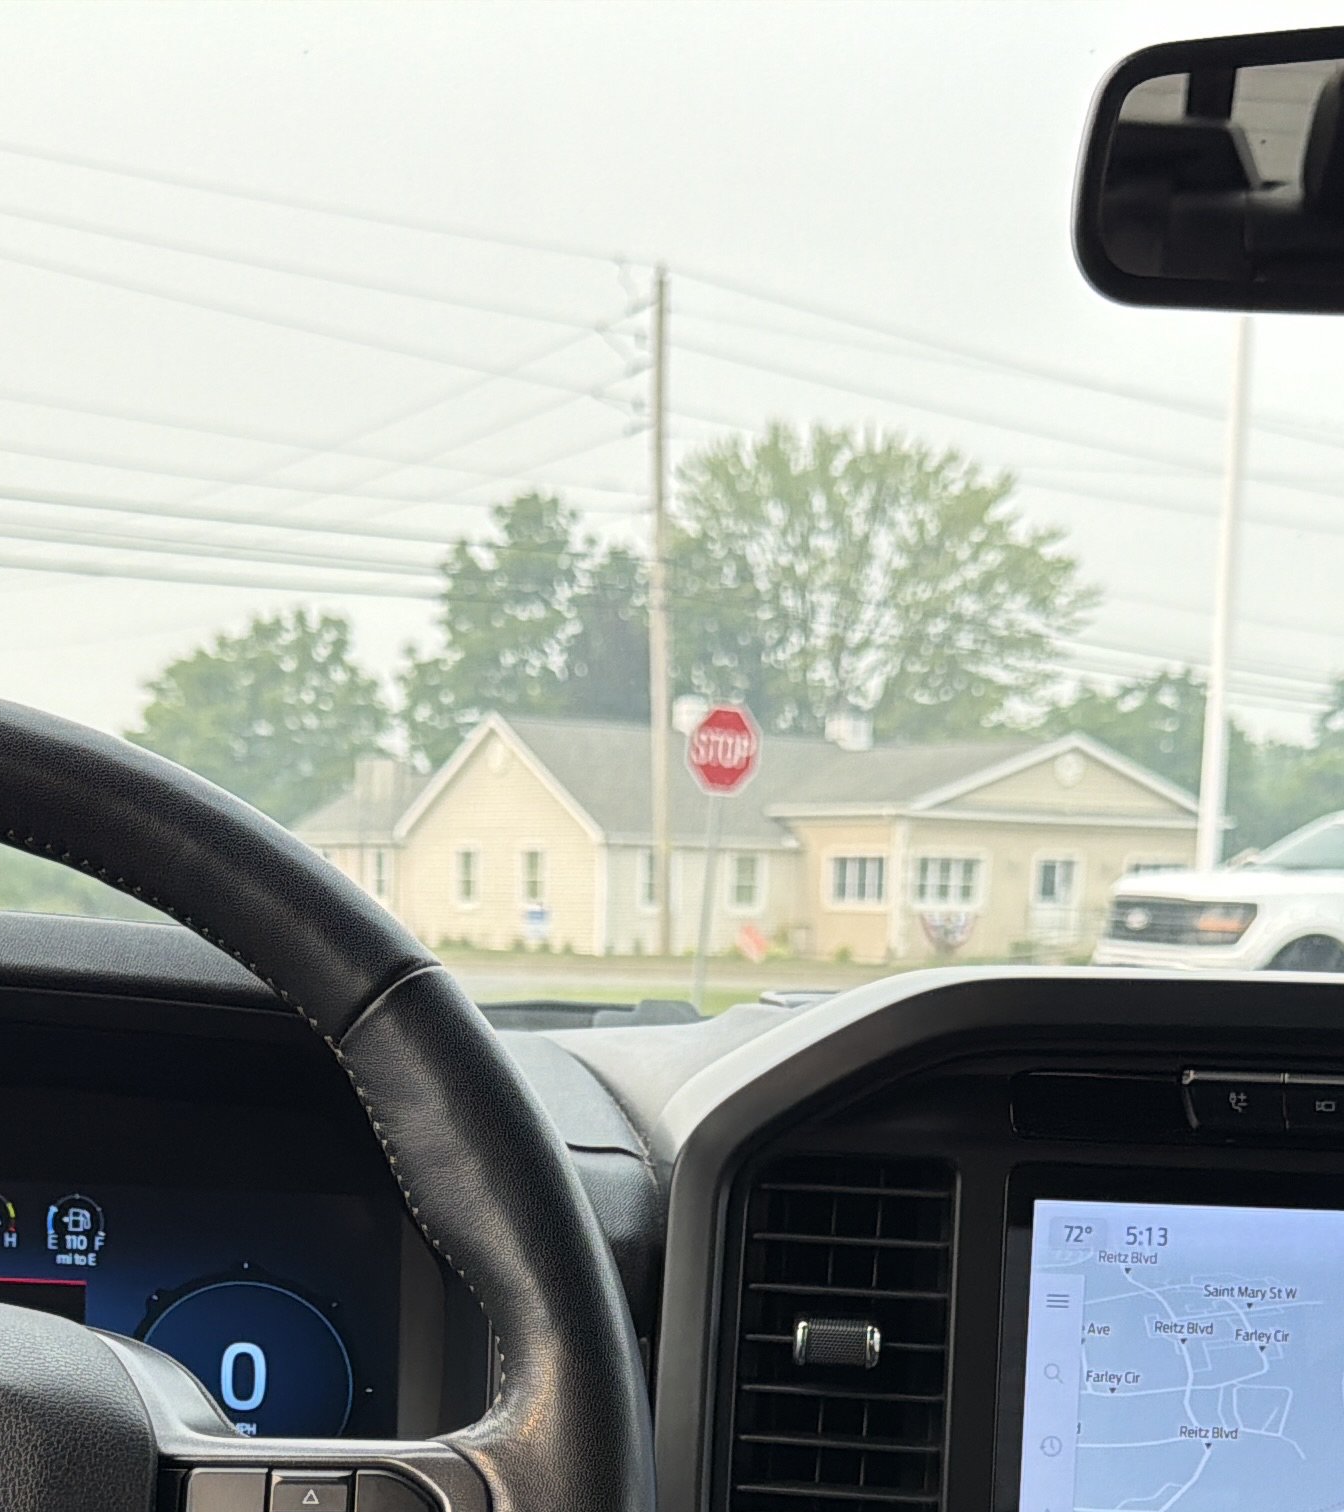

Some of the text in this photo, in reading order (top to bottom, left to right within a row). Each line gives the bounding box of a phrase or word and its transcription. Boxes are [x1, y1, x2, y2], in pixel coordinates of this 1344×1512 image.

[691, 731, 750, 768] STOP
[4, 1232, 18, 1248] H
[47, 1234, 58, 1250] E
[65, 1234, 88, 1250] 110
[94, 1235, 105, 1250] F
[1125, 1226, 1168, 1247] 5:13
[1098, 1251, 1158, 1264] Reitz Blvd
[1203, 1285, 1297, 1302] Saint Mary St W
[1087, 1321, 1110, 1336] Ave
[1154, 1321, 1214, 1335] Reitz Blvd
[1235, 1329, 1290, 1345] Farley Cir
[221, 1342, 266, 1411] 0
[1085, 1370, 1141, 1385] Farley Cir
[1179, 1426, 1239, 1440] Reitz Blvd
